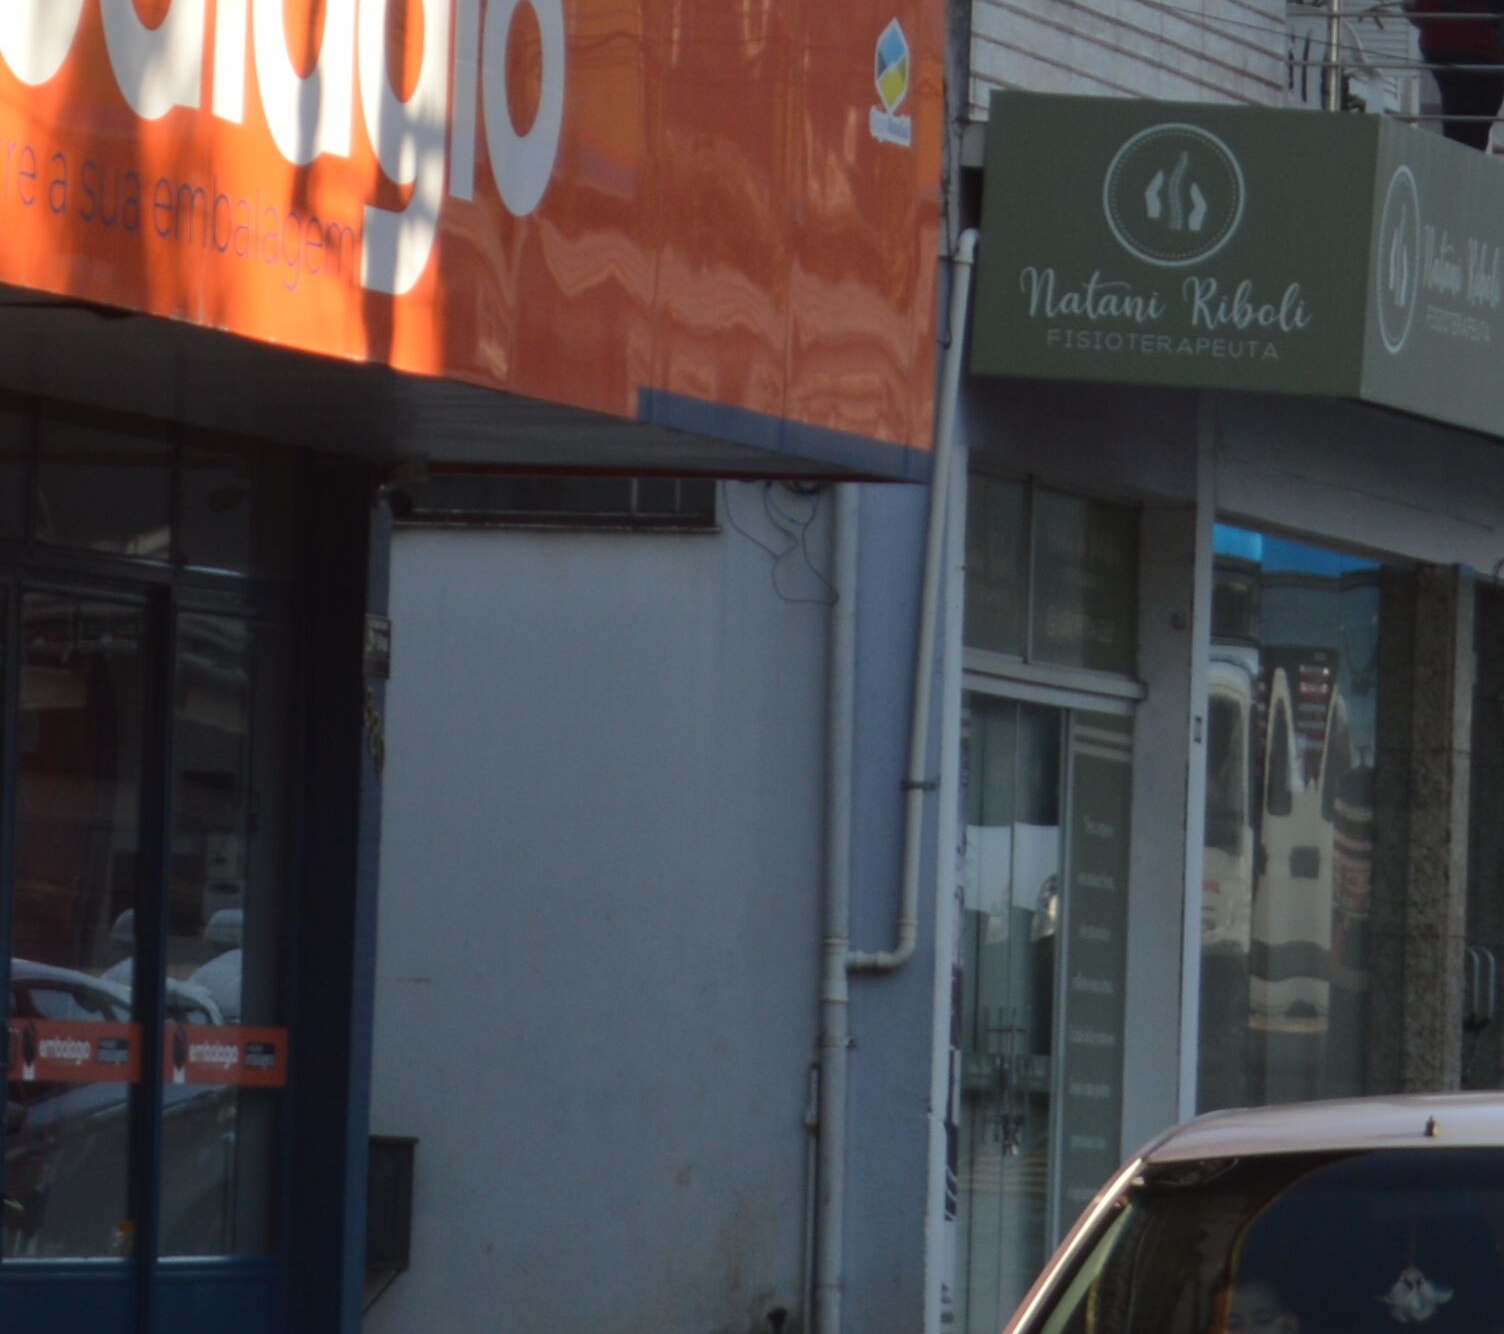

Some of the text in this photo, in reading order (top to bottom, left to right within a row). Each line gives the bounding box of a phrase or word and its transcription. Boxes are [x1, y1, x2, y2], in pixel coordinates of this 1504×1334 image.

[49, 152, 68, 214] a
[79, 159, 142, 233] sua
[153, 170, 357, 292] embalagem
[1020, 266, 1312, 332] Natani Riboli
[1047, 329, 1279, 360] FISIOTERAPEUTA
